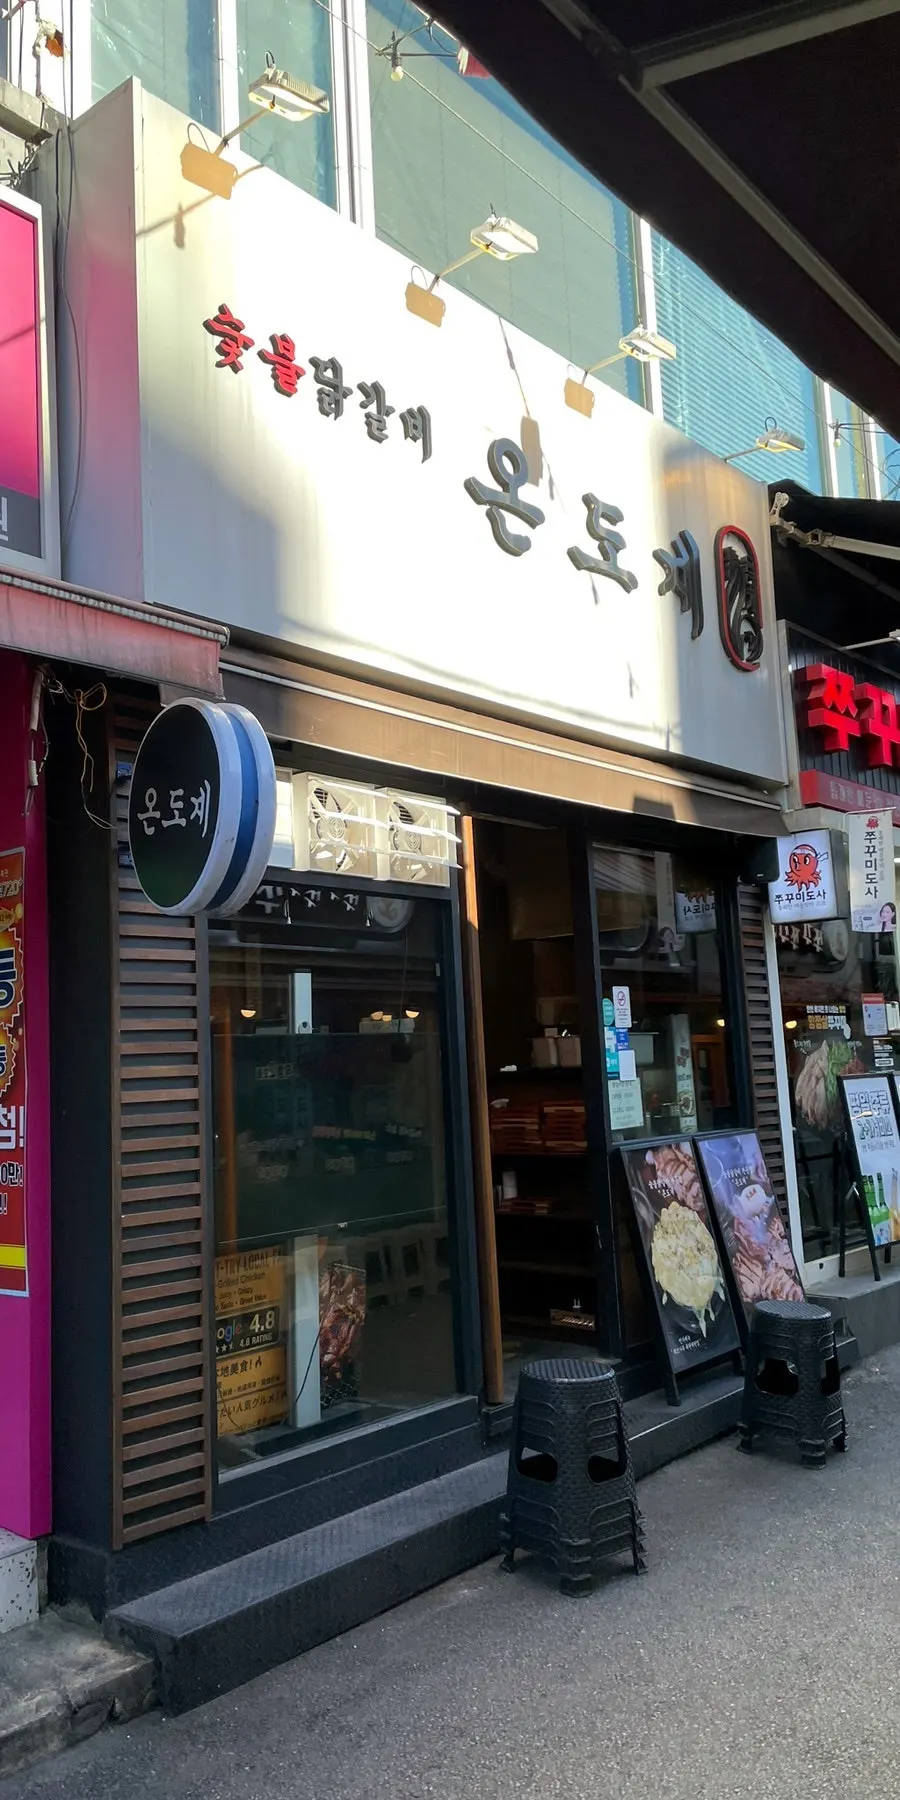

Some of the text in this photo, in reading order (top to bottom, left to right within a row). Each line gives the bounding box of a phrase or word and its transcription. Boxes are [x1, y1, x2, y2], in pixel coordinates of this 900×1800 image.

[203, 303, 432, 464] 숯불닭갈비
[801, 663, 900, 768] 쭈꾸
[864, 831, 878, 899] 쭈꾸미도사
[774, 889, 826, 905] 쭈꾸미도사
[239, 1333, 273, 1348] 4.8 RATING
[250, 1310, 275, 1333] 4.8
